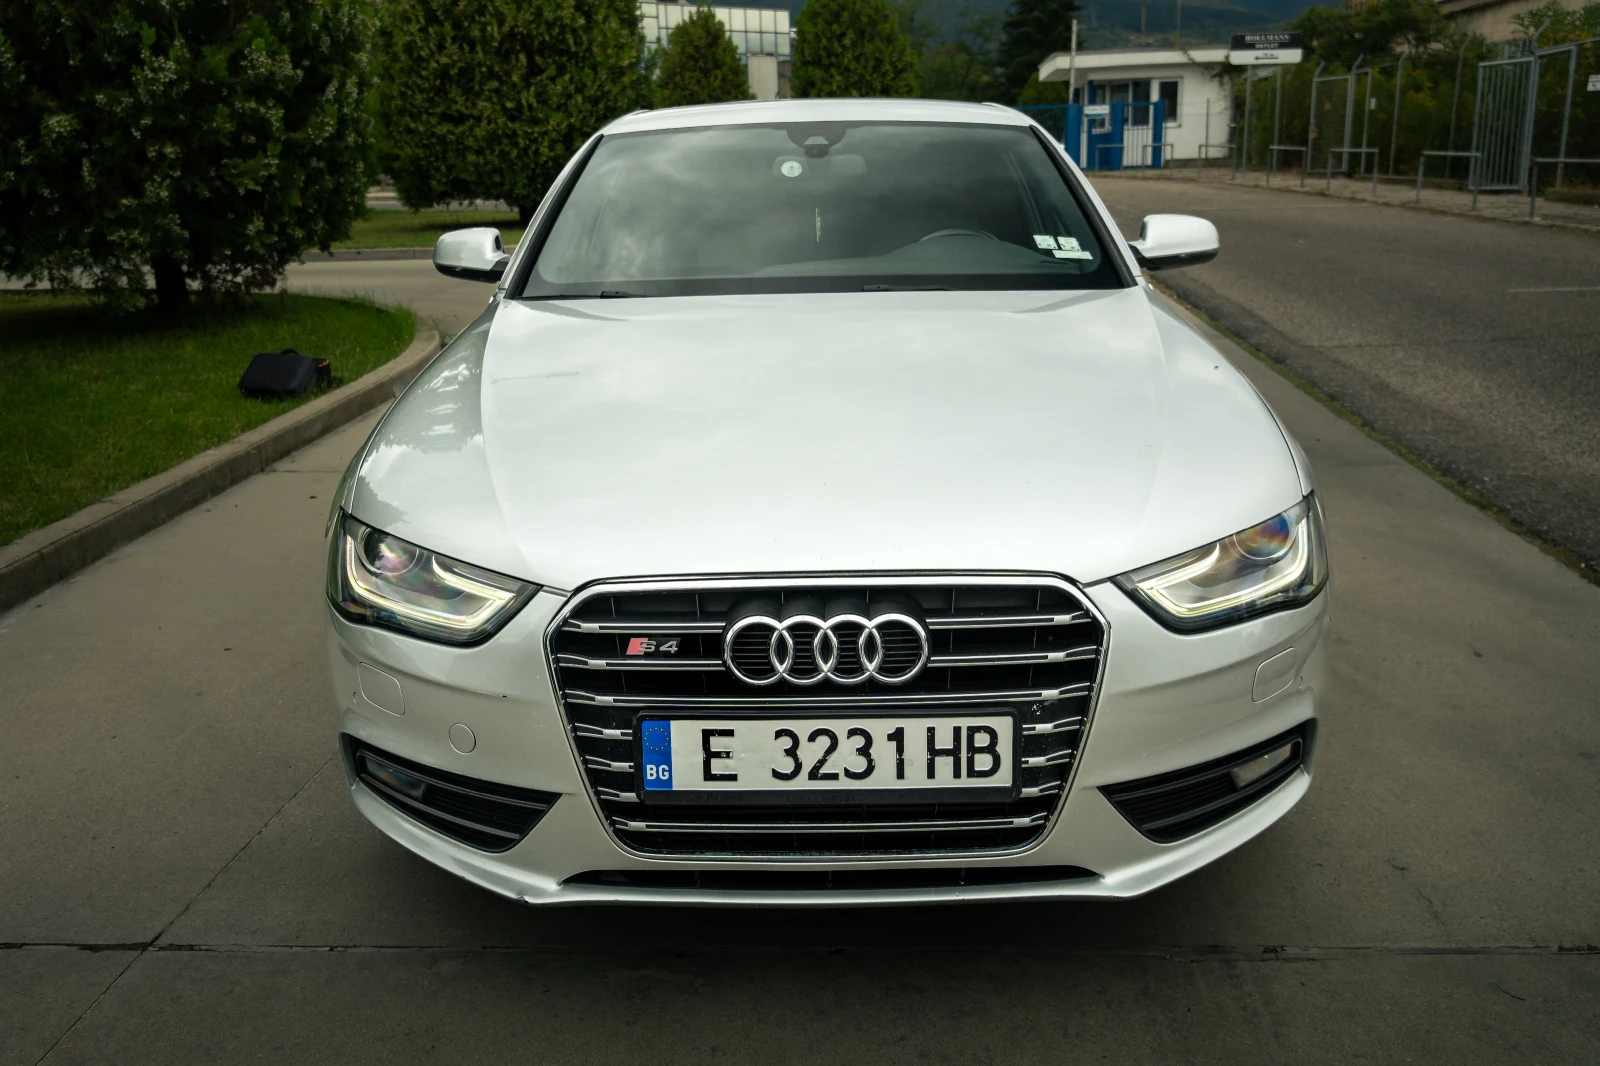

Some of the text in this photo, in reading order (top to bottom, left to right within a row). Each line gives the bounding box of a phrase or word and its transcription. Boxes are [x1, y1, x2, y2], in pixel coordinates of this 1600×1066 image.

[638, 640, 679, 654] S4
[702, 725, 1002, 781] E 3231 HB
[646, 764, 670, 780] BG
